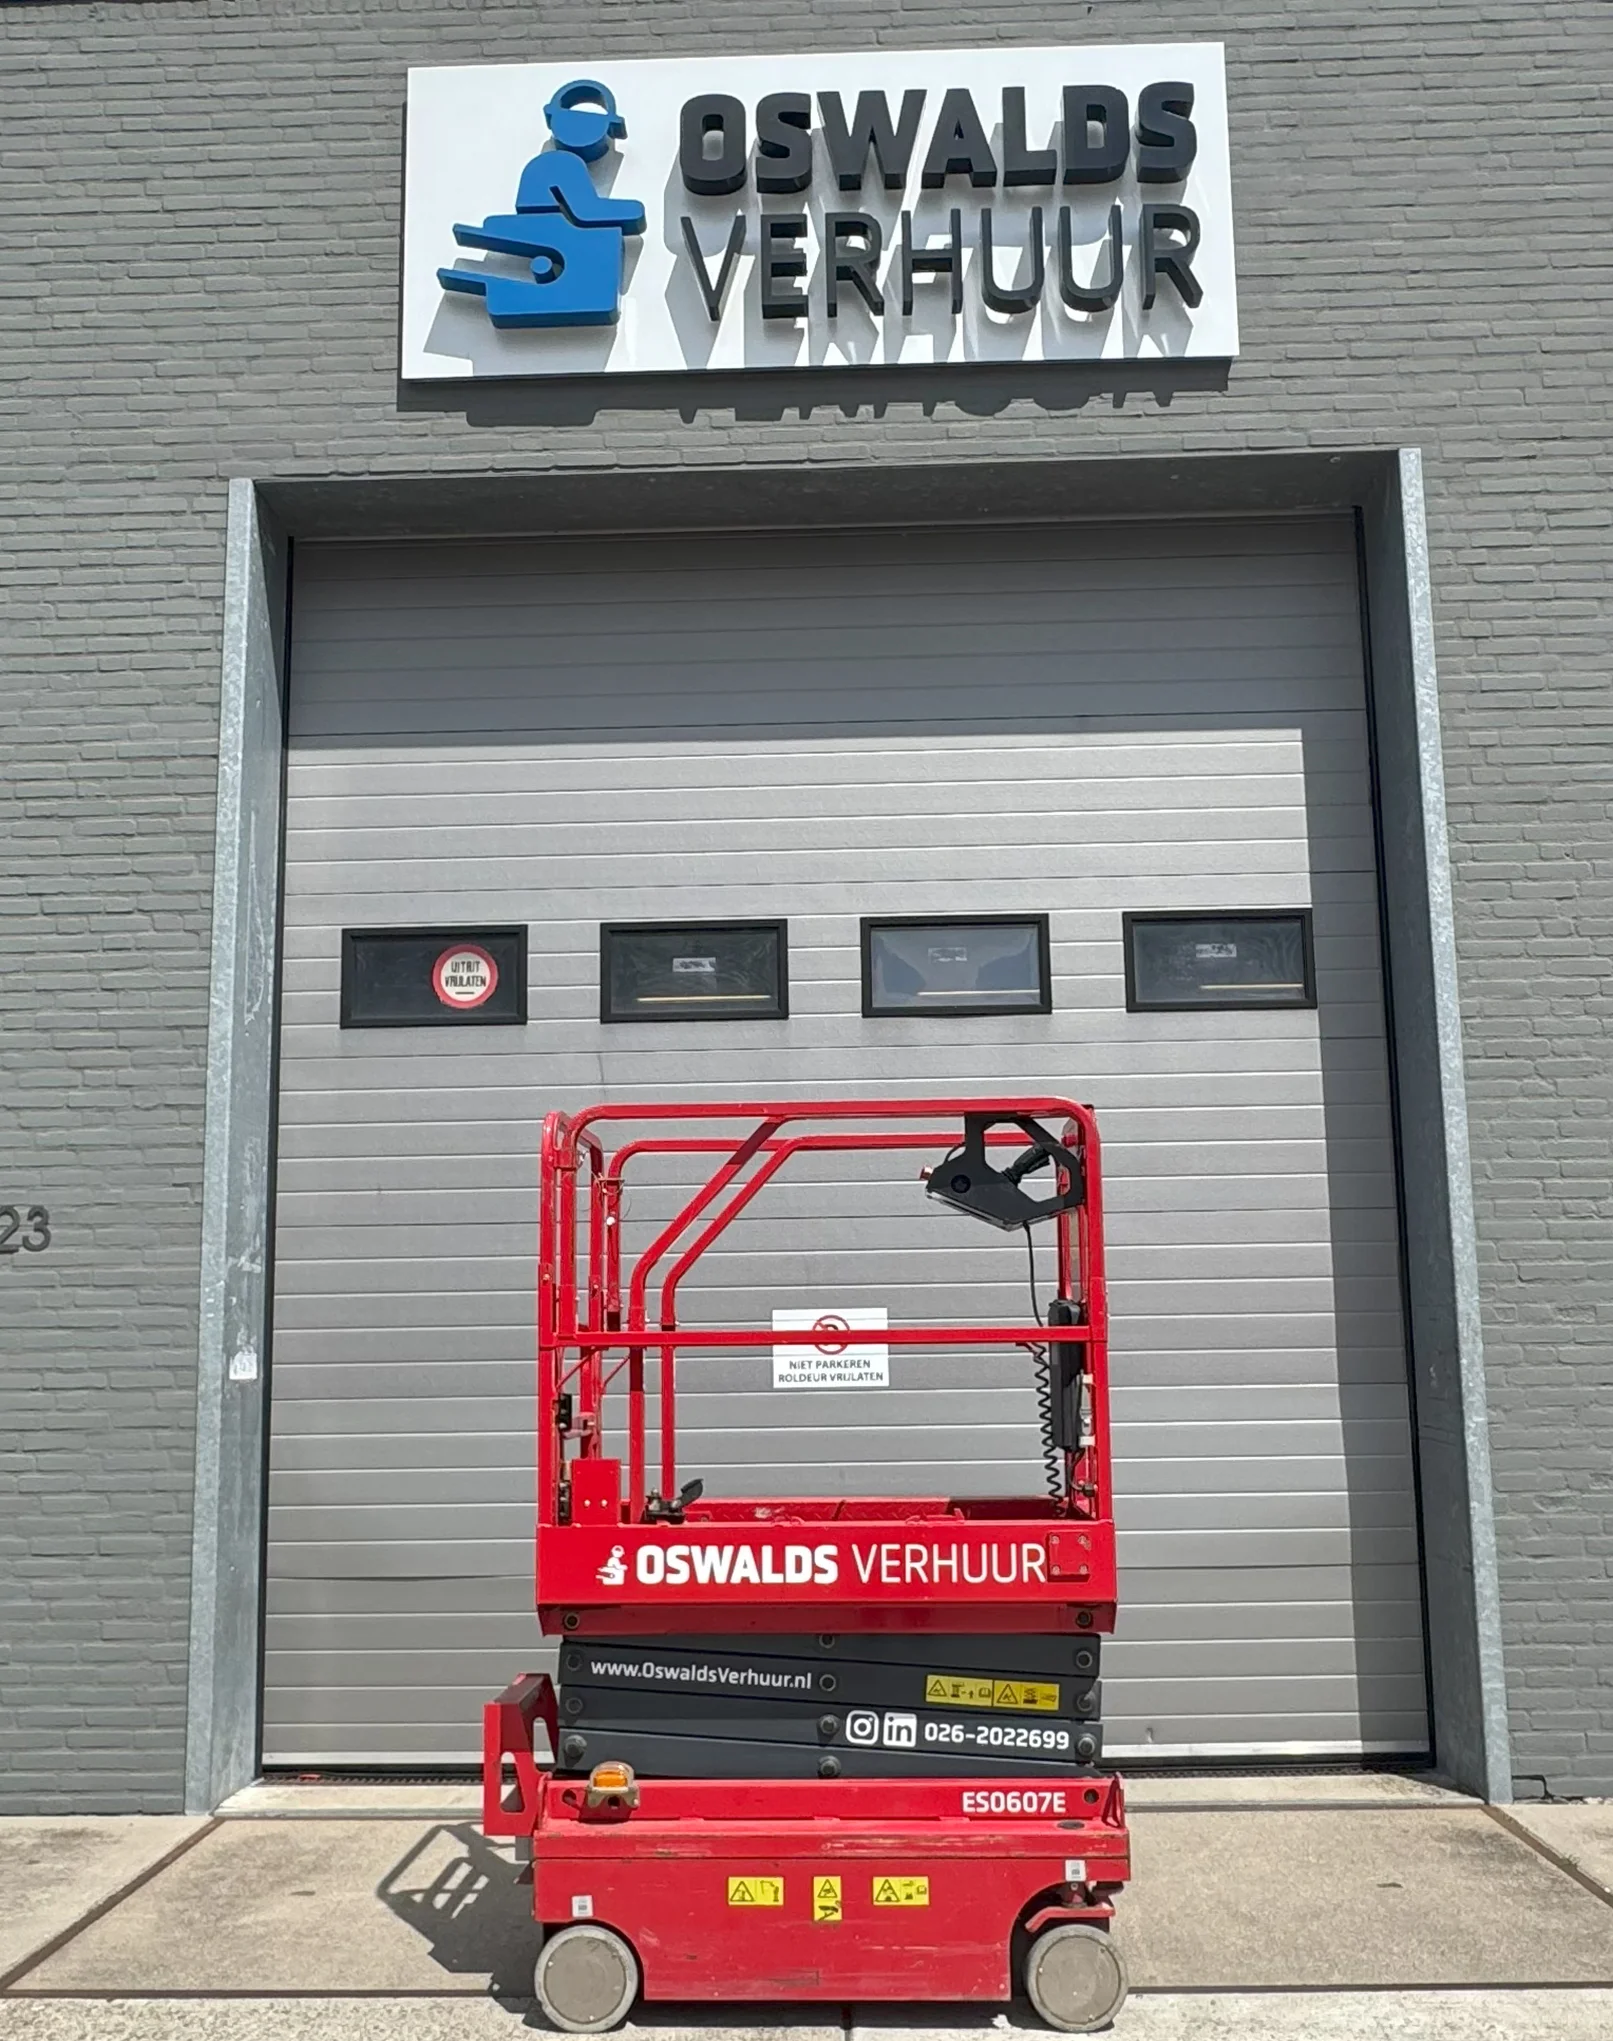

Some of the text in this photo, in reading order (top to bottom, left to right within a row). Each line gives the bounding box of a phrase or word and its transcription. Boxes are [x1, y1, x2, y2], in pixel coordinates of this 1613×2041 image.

[679, 81, 1198, 195] OSWALDS
[681, 203, 1204, 321] VERHUUR
[450, 960, 480, 973] UITRIT
[444, 975, 487, 987] VRIJLATEN
[0, 1205, 51, 1254] 23
[778, 1371, 884, 1383] ROLDEUR VRIJLATEN
[789, 1359, 871, 1370] NIET PARKEREN
[635, 1543, 1046, 1585] OSWALDS VERHUUR
[590, 1660, 813, 1690] www.OswaldsVerhuur.nl
[924, 1722, 1070, 1750] 026-2022699
[961, 1790, 1067, 1813] ES0607E
